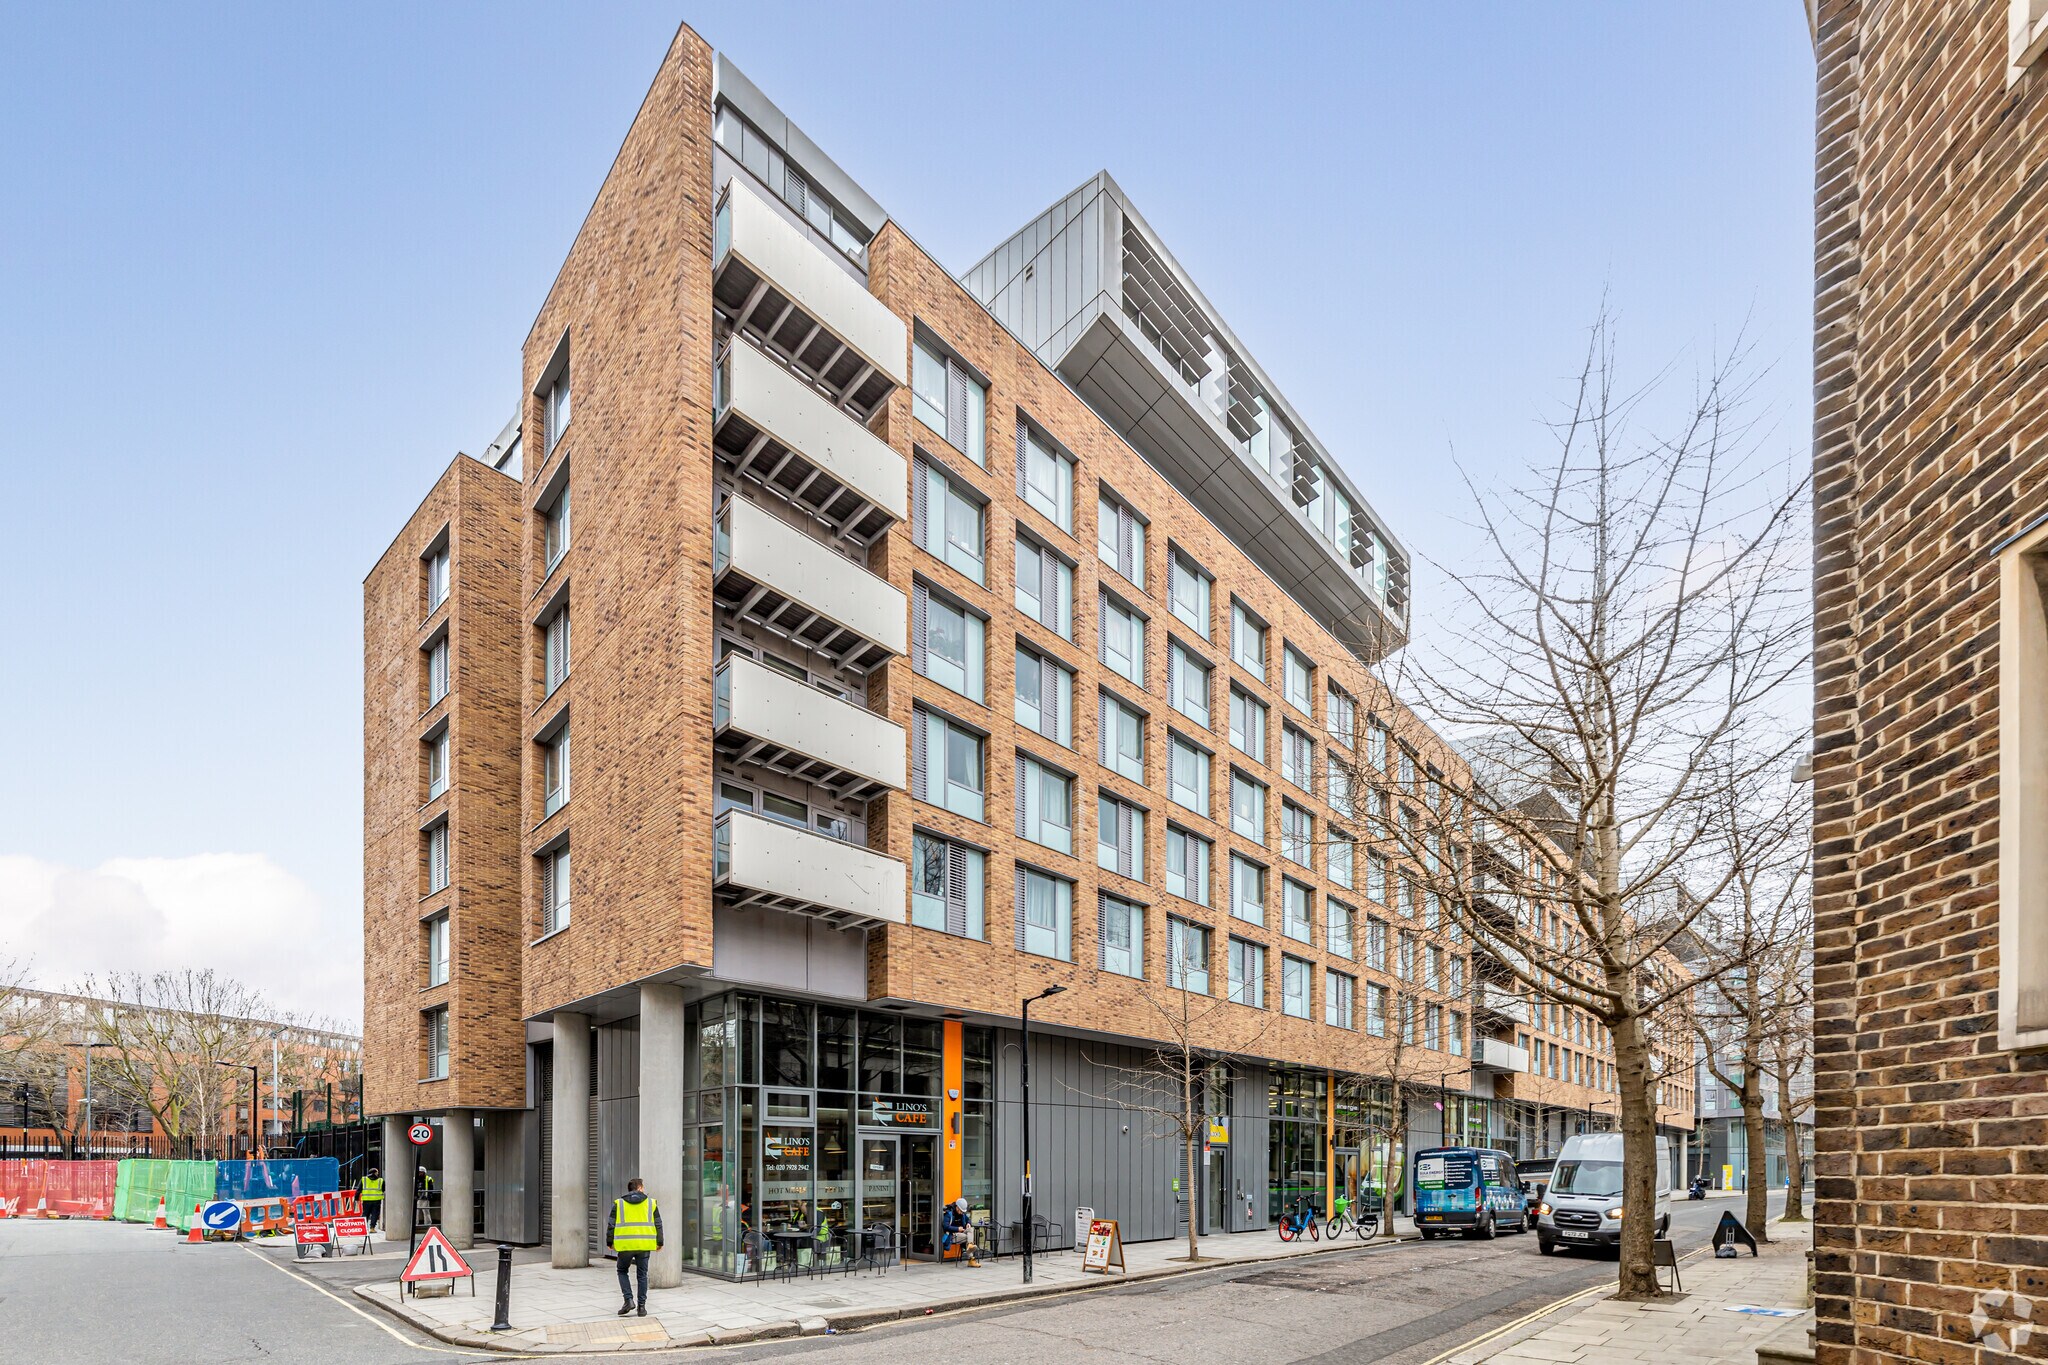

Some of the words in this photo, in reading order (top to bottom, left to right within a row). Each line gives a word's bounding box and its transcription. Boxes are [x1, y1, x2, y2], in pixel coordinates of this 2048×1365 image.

[896, 1102, 927, 1112] LINO'S
[895, 1112, 927, 1124] CAFE
[412, 1129, 430, 1139] 20
[784, 1137, 810, 1146] LINO'S
[783, 1146, 810, 1157] CAFE
[768, 1187, 784, 1195] HOT
